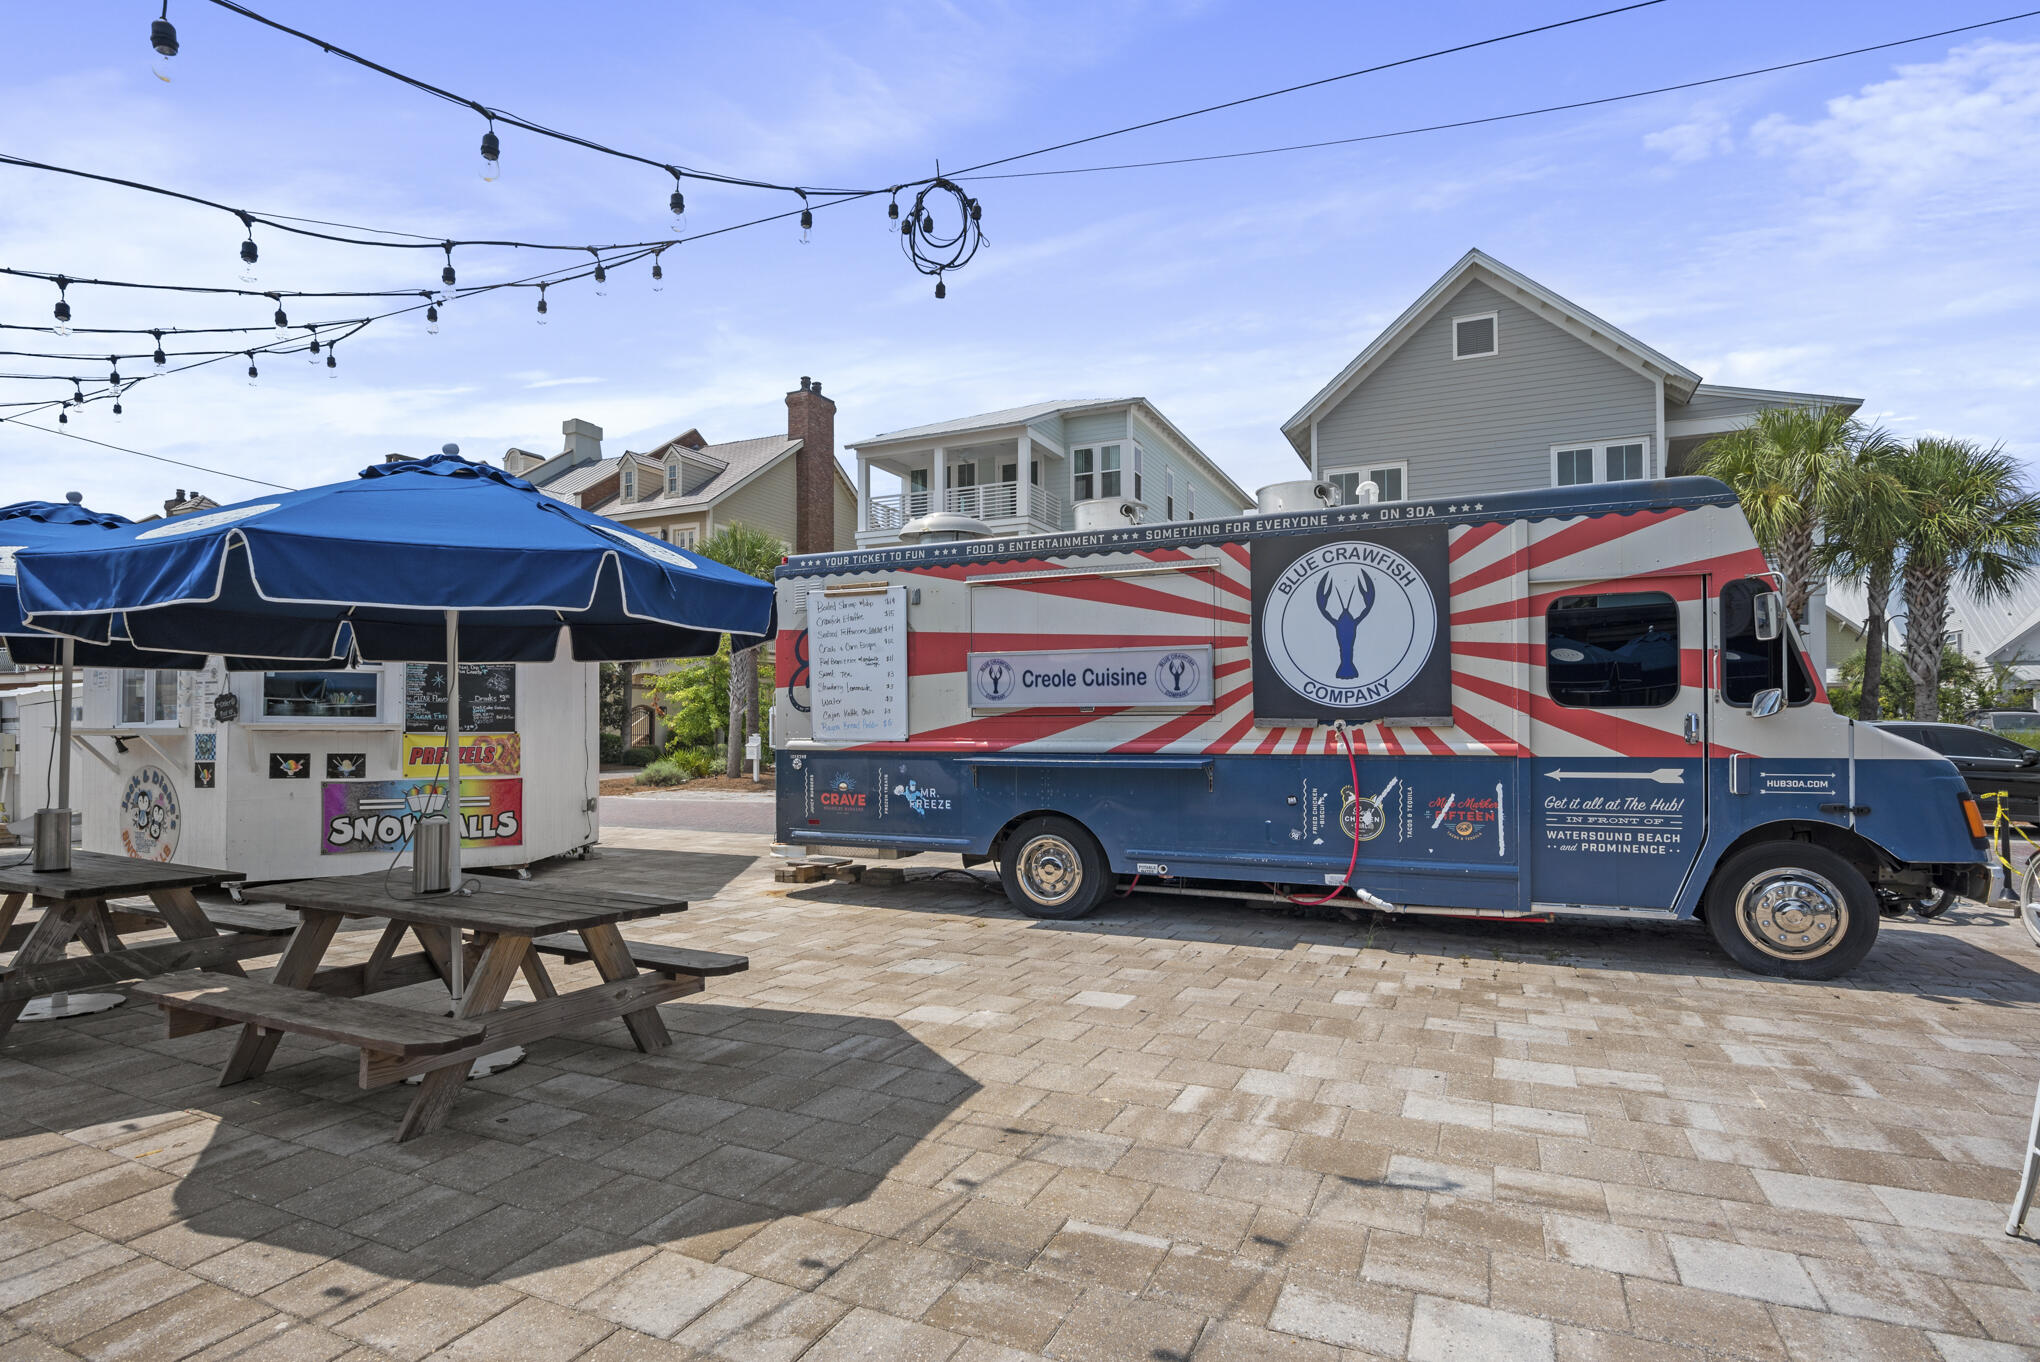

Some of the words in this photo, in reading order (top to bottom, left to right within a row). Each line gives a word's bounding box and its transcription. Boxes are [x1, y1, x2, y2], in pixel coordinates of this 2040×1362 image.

[1380, 508, 1399, 520] ON
[1406, 506, 1435, 518] 30A
[1146, 524, 1220, 540] SOMETHING
[1225, 522, 1250, 533] FOR
[1256, 515, 1328, 531] EVERYONE
[966, 544, 994, 555] FOOD
[1000, 543, 1005, 552] &
[1010, 535, 1105, 551] ENTERTAINMENT
[825, 556, 849, 566] YOUR
[853, 553, 887, 564] TICKET
[890, 551, 901, 561] TO
[905, 550, 925, 559] FUN
[1278, 556, 1319, 596] BLUE
[1322, 547, 1416, 587] CRAWFISH
[1022, 669, 1077, 688] Creole
[1082, 668, 1147, 687] Cuisine
[1303, 679, 1390, 703] COMPANY
[821, 698, 841, 707] Water
[408, 746, 496, 765] PREZELS
[1766, 779, 1828, 788] HUB30A.COM
[821, 793, 866, 806] CRAVE
[920, 788, 940, 798] MR.
[910, 799, 951, 809] FREEZE
[1544, 796, 1566, 809] Get
[1569, 797, 1580, 809] it
[1582, 797, 1603, 810] all
[1605, 799, 1621, 810] at
[1623, 797, 1647, 810] The
[1650, 798, 1685, 811] Hub!
[328, 810, 518, 846] SNOWLLS
[1546, 830, 1632, 841] WATERSOUND
[1637, 833, 1680, 843] BEACH
[1559, 843, 1578, 851] and
[1581, 843, 1666, 855] PROMINENCE
